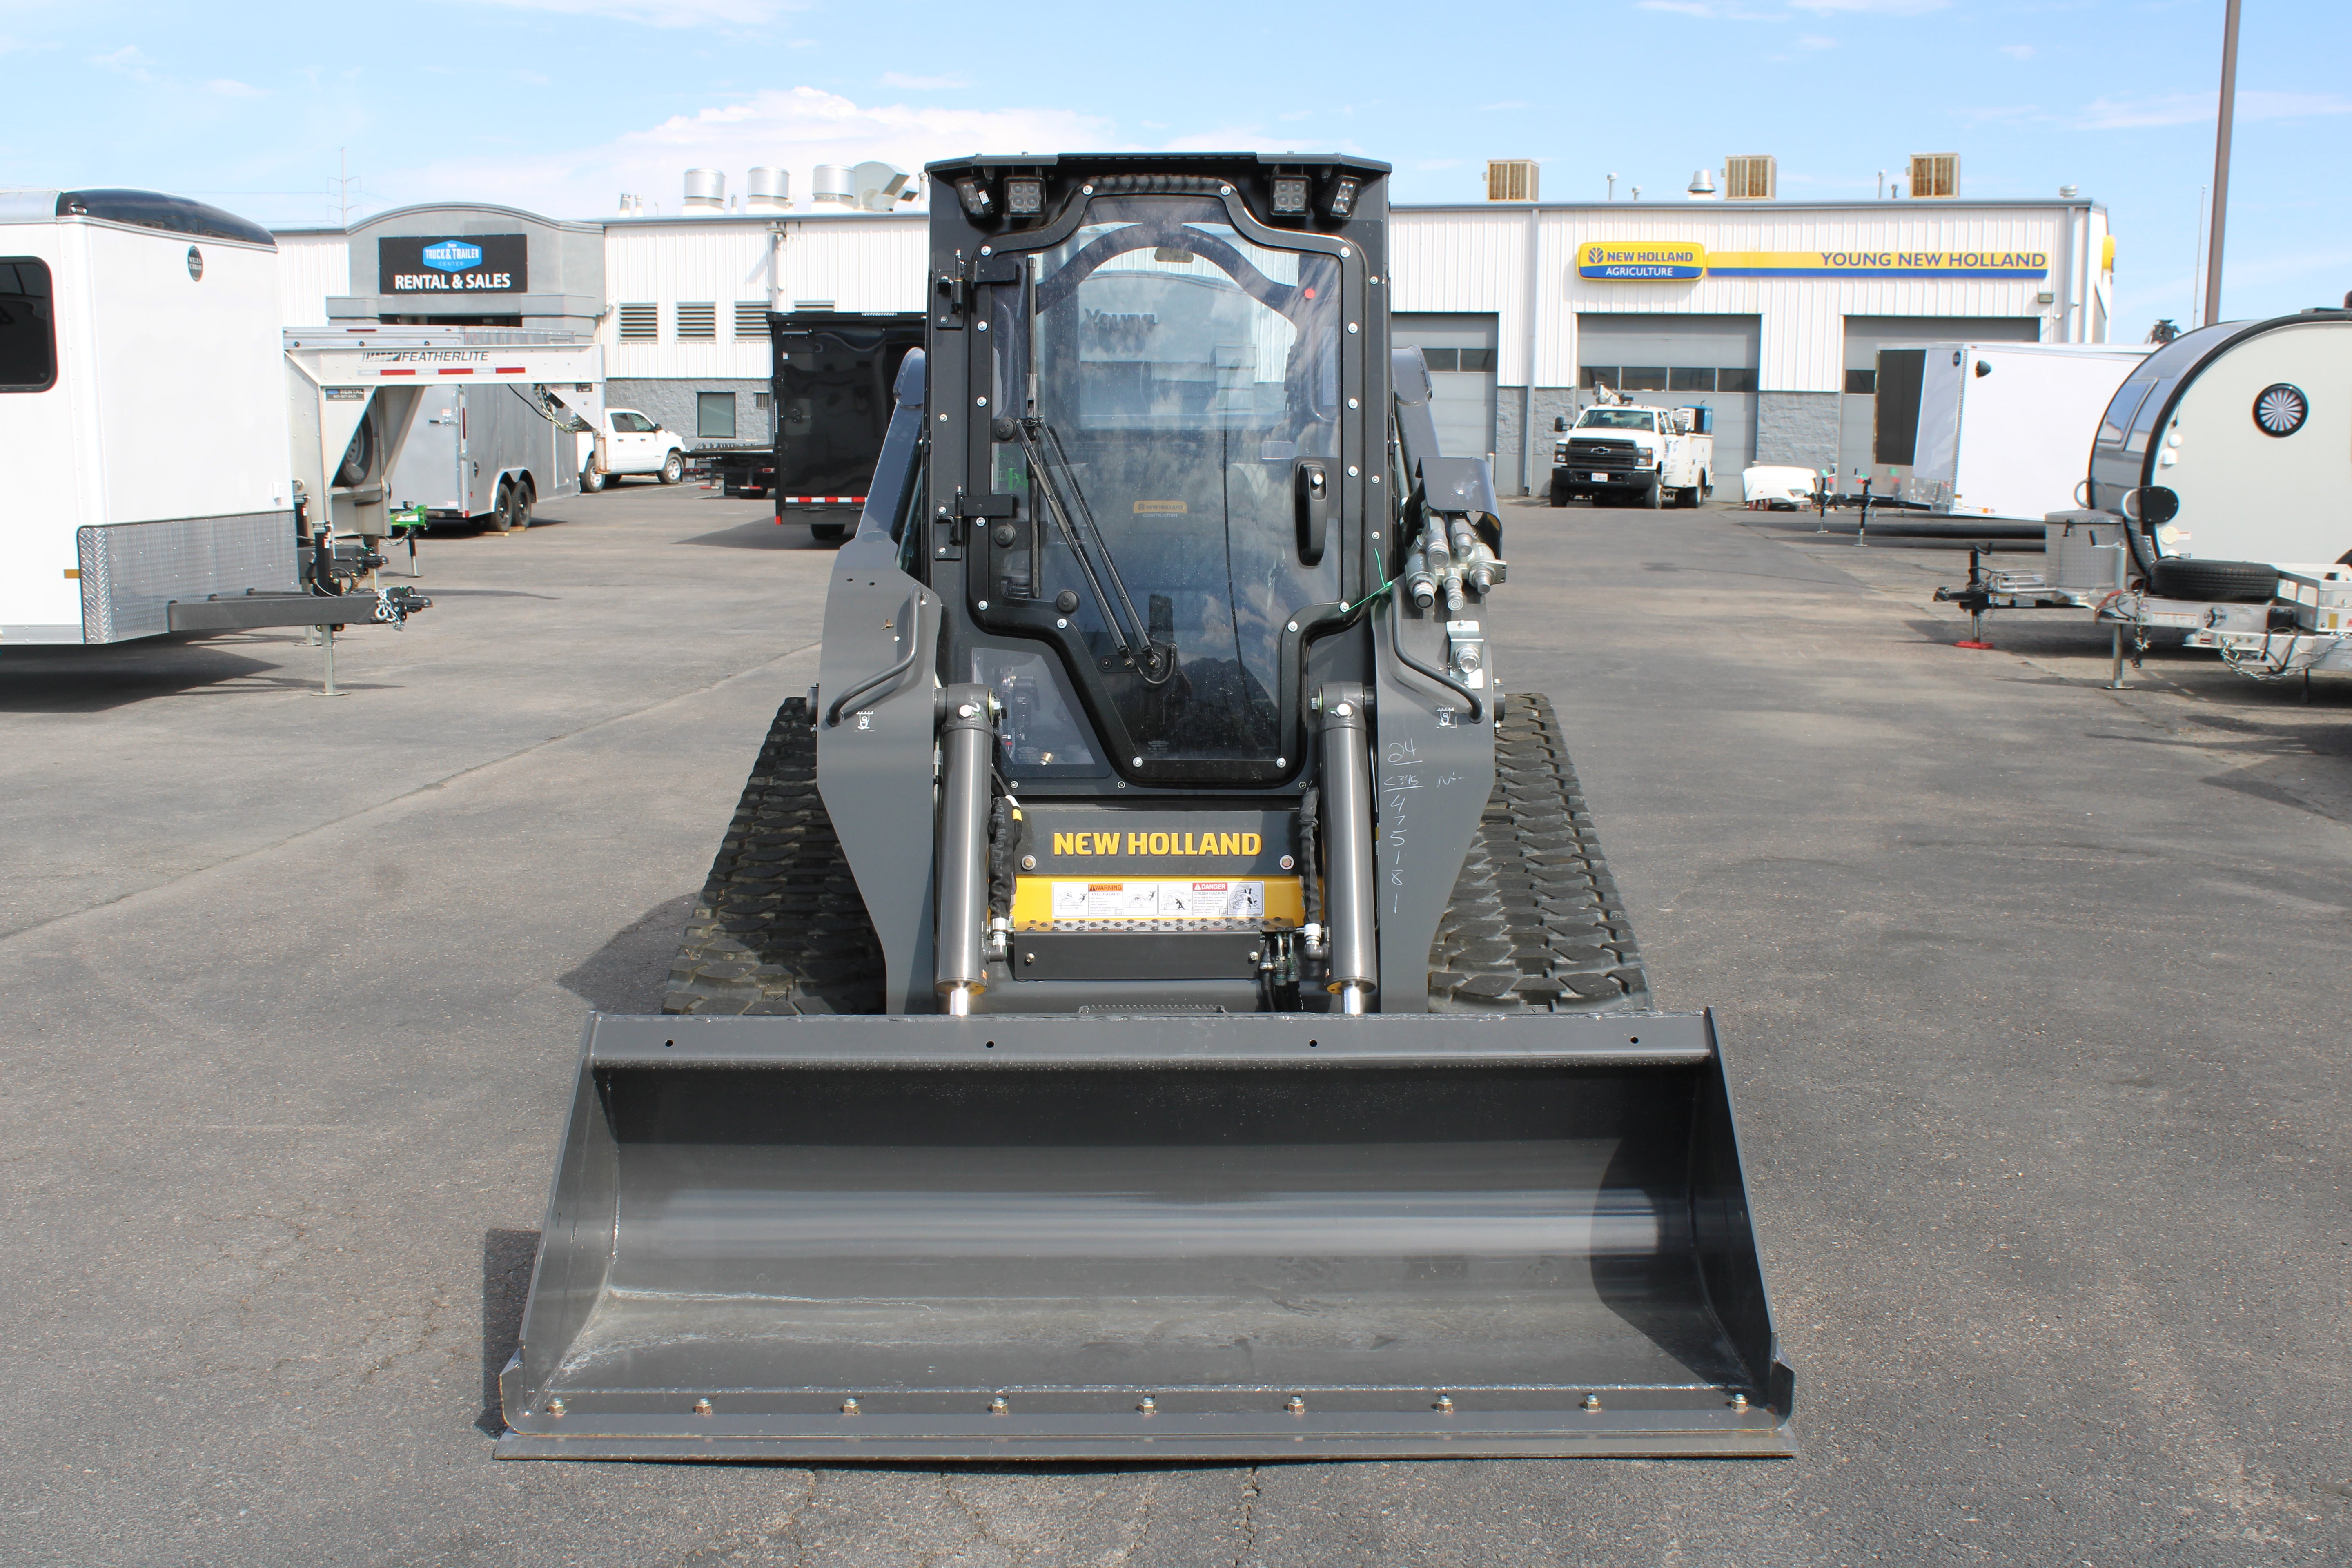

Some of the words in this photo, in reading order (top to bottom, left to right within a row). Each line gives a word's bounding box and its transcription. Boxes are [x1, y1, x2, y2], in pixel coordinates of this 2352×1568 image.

[425, 249, 445, 259] TRUCK
[452, 248, 479, 259] TRAILER
[1607, 252, 1635, 262] NEW
[1637, 252, 1693, 262] HOLLAND
[1820, 252, 1891, 266] YOUNG
[1898, 253, 1943, 266] NEW
[1949, 253, 2046, 267] HOLLAND
[1605, 267, 1673, 276] AGRICULTURE
[394, 274, 449, 290] RENTAL
[452, 273, 463, 289] &
[466, 273, 510, 289] SALES
[401, 351, 490, 362] FEATHERLITE
[1388, 738, 1417, 763] 24
[1054, 832, 1121, 855] NEW
[1127, 832, 1263, 856] HOLLAND
